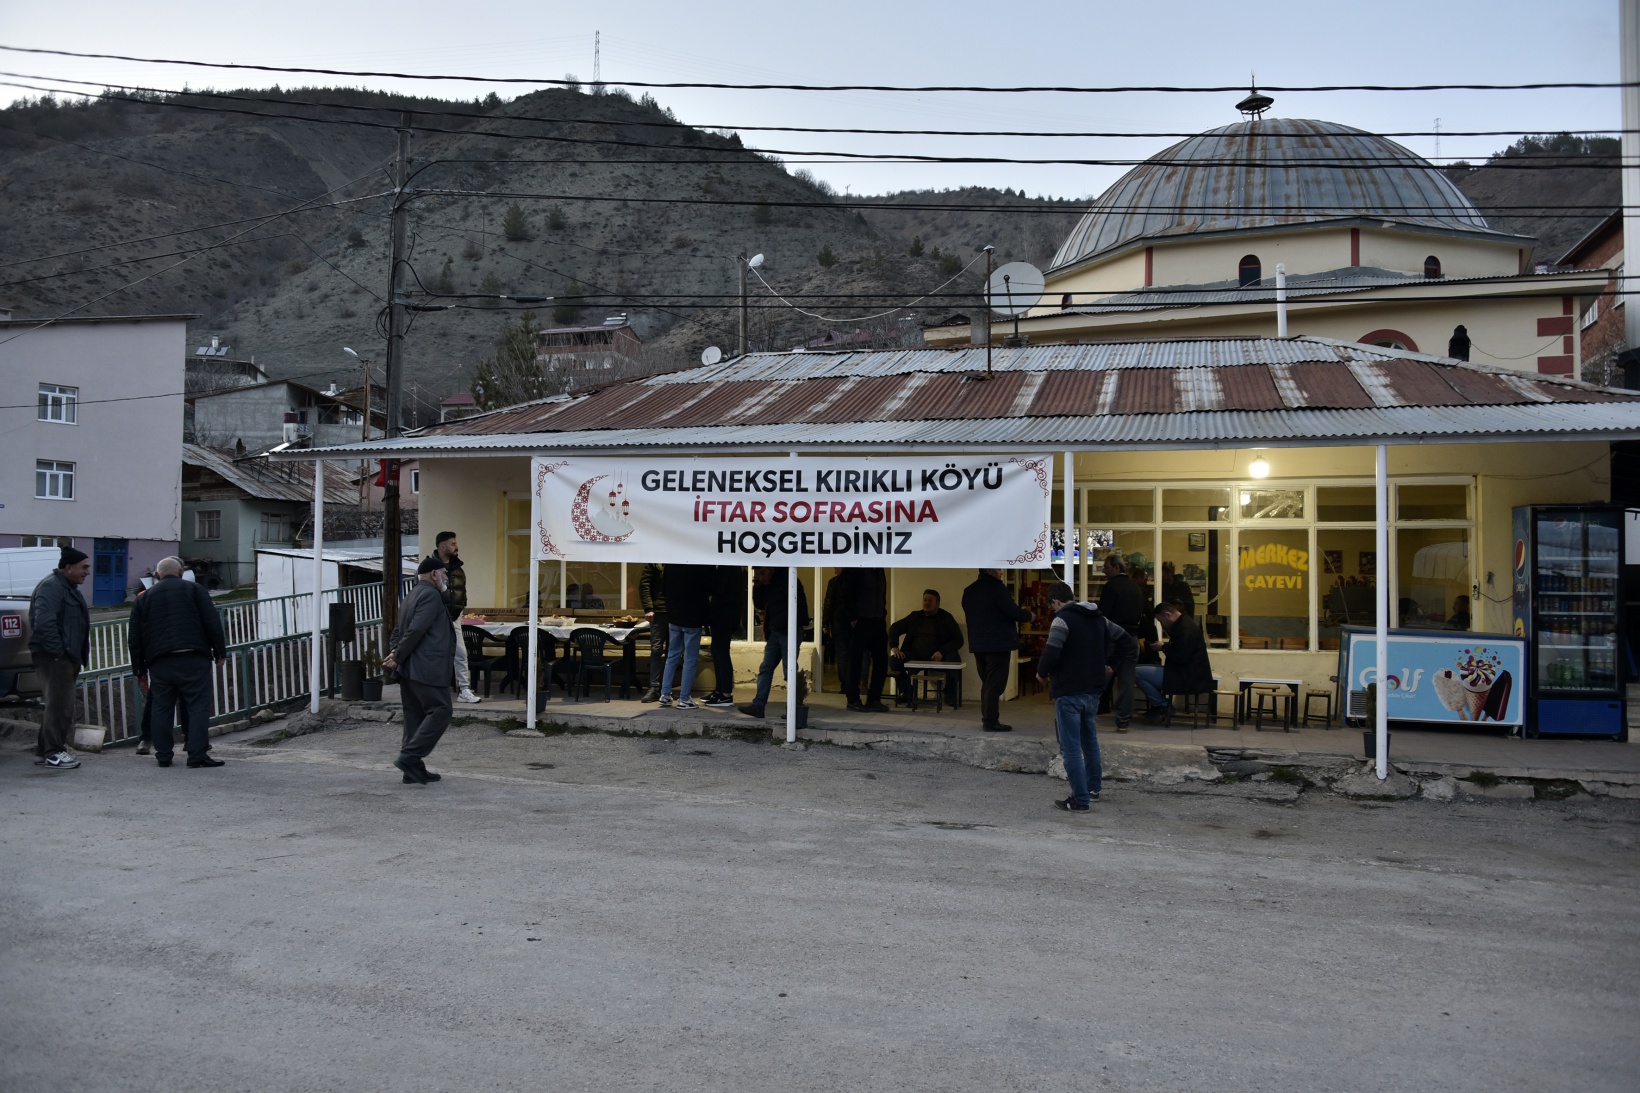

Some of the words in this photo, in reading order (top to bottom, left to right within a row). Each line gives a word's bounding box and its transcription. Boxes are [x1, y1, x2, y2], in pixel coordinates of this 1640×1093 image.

[641, 469, 809, 492] GELENEKSEL
[816, 469, 912, 492] KIRIKLI
[921, 462, 1003, 491] KÖYÜ
[693, 495, 766, 523] İFTAR
[772, 499, 939, 523] SOFRASINA
[1569, 518, 1600, 529] pepsi
[717, 526, 913, 558] HOŞGELDİNİZ
[1240, 543, 1308, 571] MERKEZ
[1245, 572, 1302, 591] ÇAYEVİ
[4, 618, 18, 628] 112
